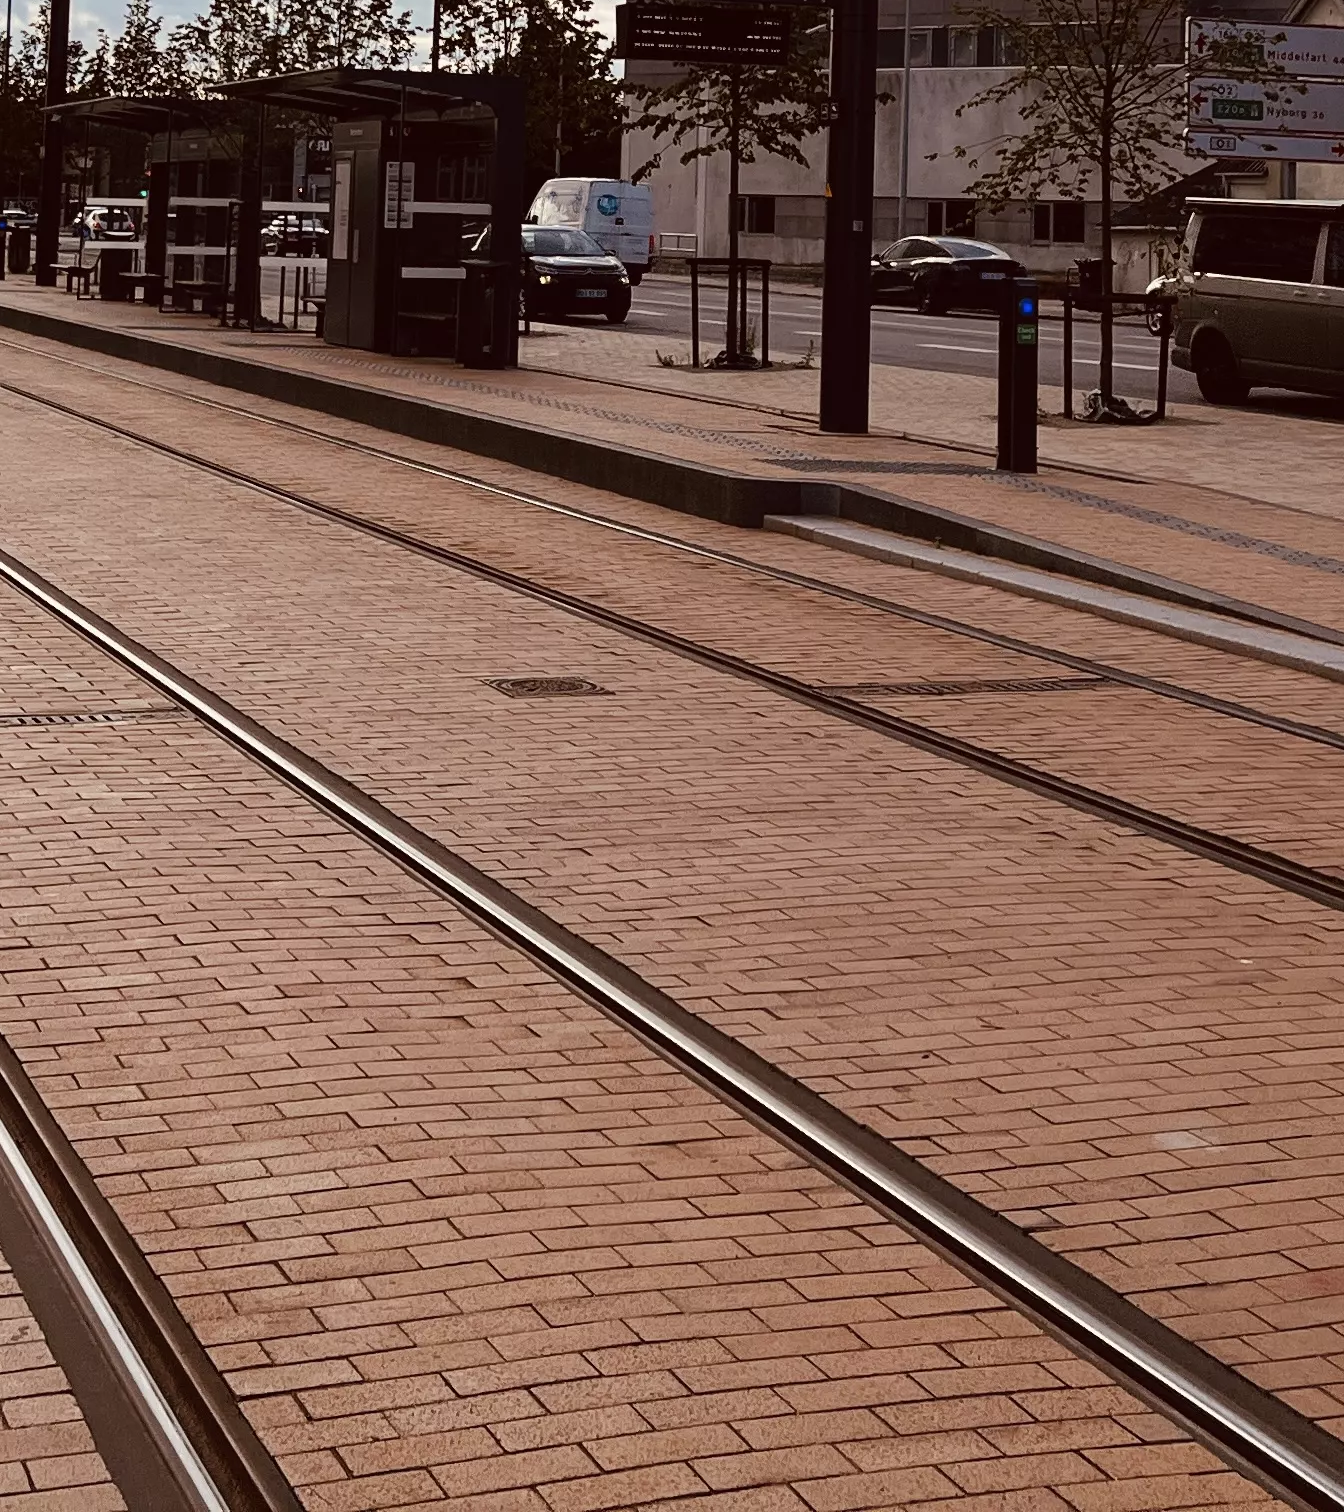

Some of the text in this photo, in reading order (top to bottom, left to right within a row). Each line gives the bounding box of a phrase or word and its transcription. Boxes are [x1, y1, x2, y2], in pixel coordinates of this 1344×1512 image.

[1267, 50, 1327, 63] Middelfart
[1266, 106, 1325, 120] Nyborg 36
